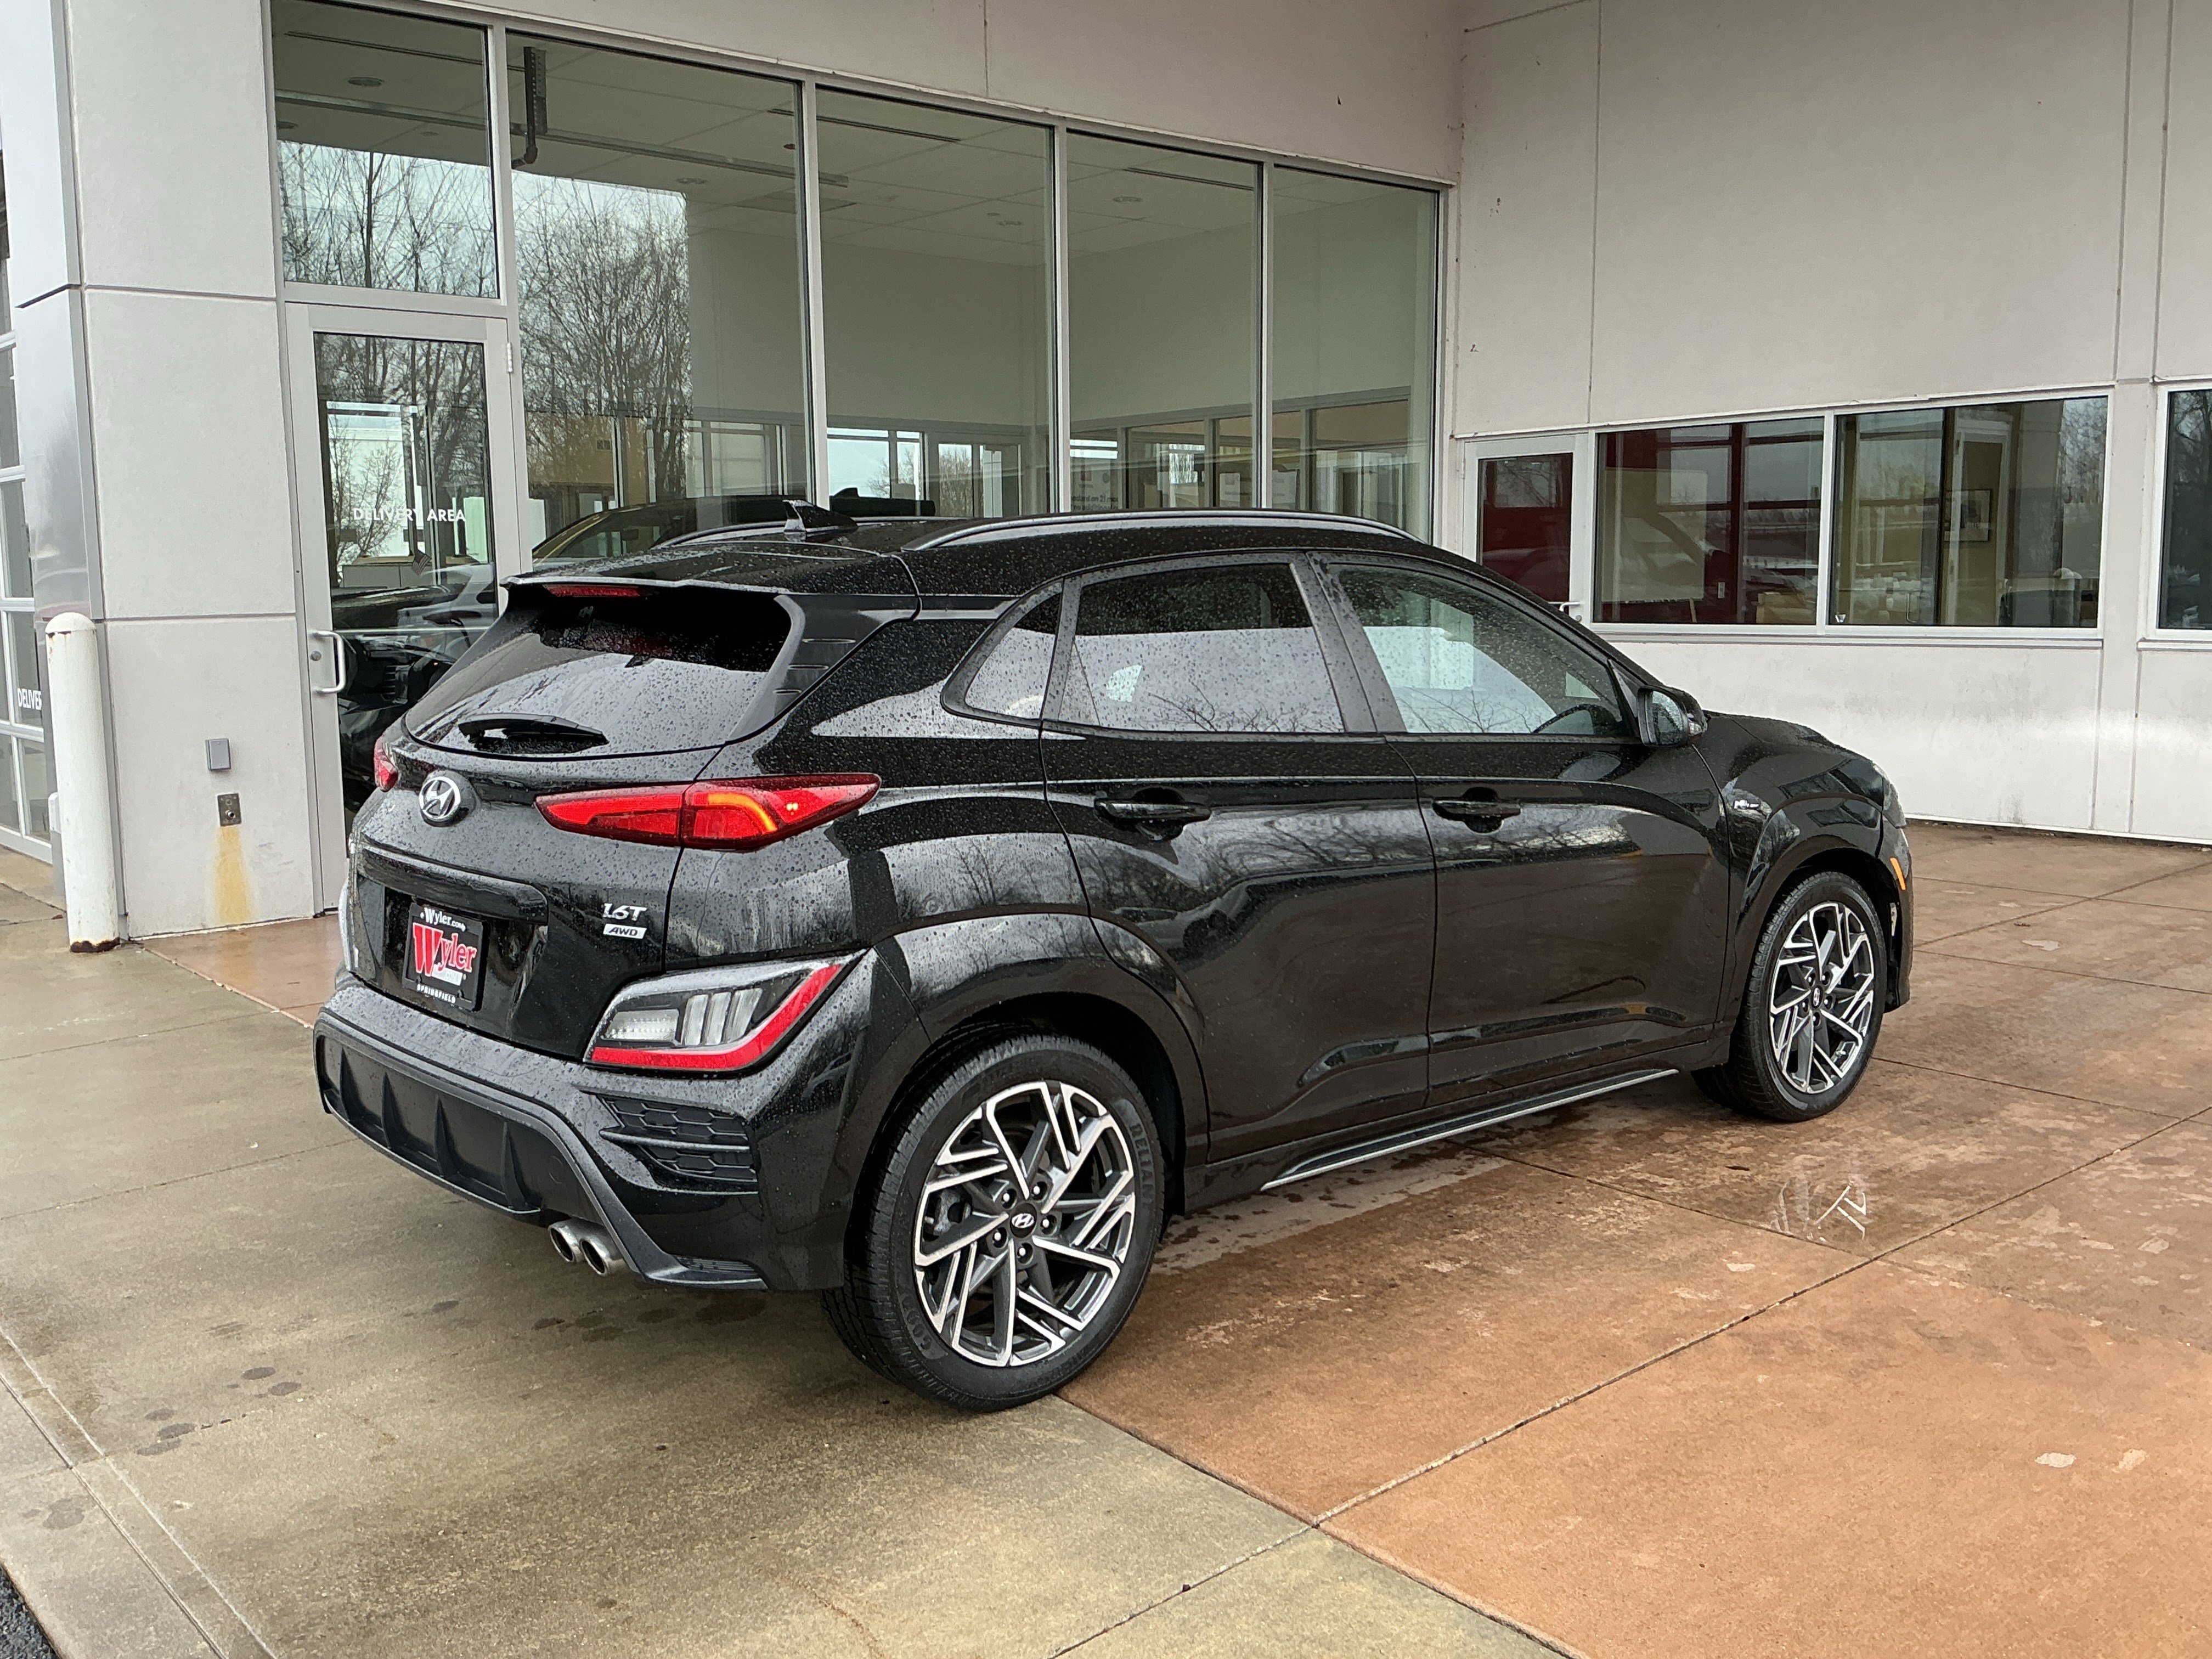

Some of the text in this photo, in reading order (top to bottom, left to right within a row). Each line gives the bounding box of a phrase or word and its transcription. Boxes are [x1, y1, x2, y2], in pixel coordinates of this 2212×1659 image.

[427, 509, 466, 521] AREA
[608, 927, 639, 936] AWD
[413, 922, 477, 977] Wyler
[417, 983, 456, 1004] SPRINGFIELD
